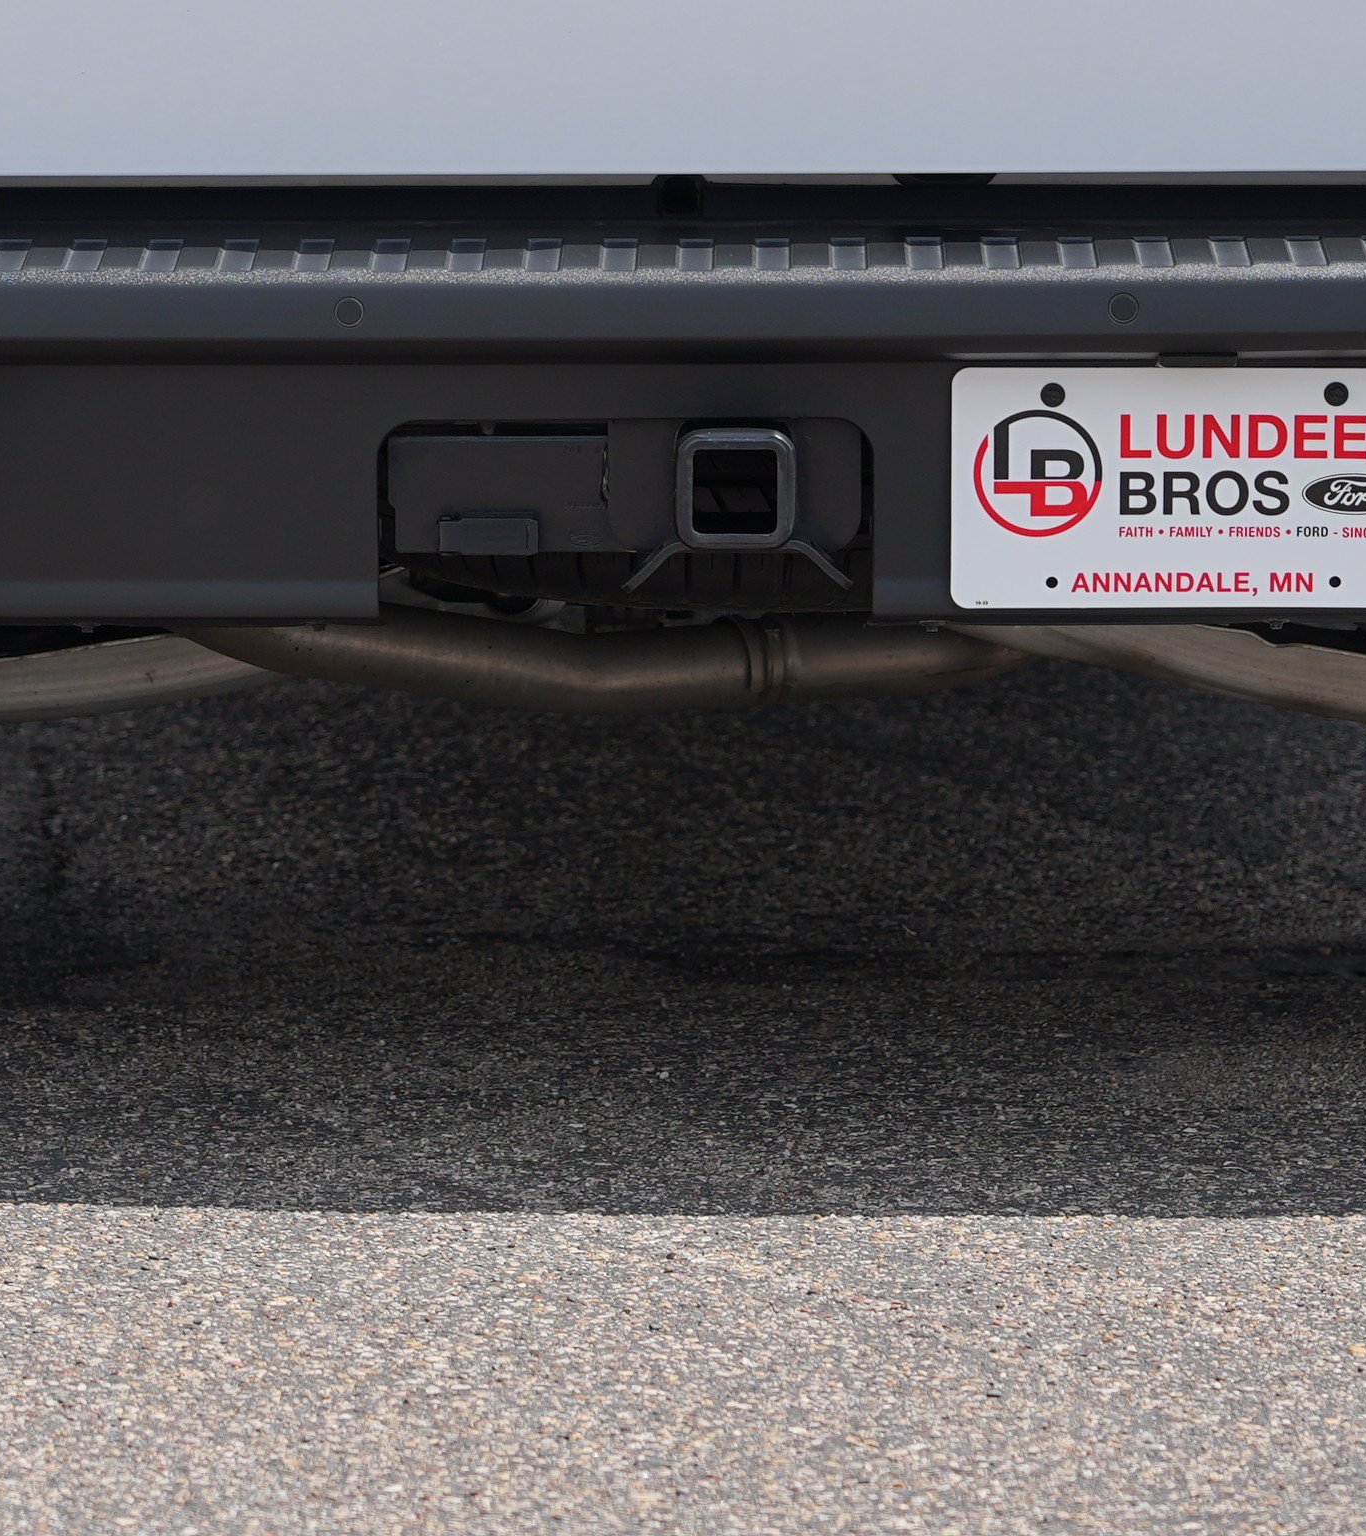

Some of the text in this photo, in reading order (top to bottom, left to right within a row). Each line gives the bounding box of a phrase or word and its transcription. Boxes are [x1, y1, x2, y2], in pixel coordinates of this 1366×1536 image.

[1119, 470, 1291, 517] BROS
[1119, 526, 1154, 539] FAITH
[1169, 526, 1213, 539] FAMILY
[1228, 526, 1281, 539] FRIENDS
[1296, 526, 1329, 539] FORD
[1071, 572, 1314, 597] ANNANDALE, MN
